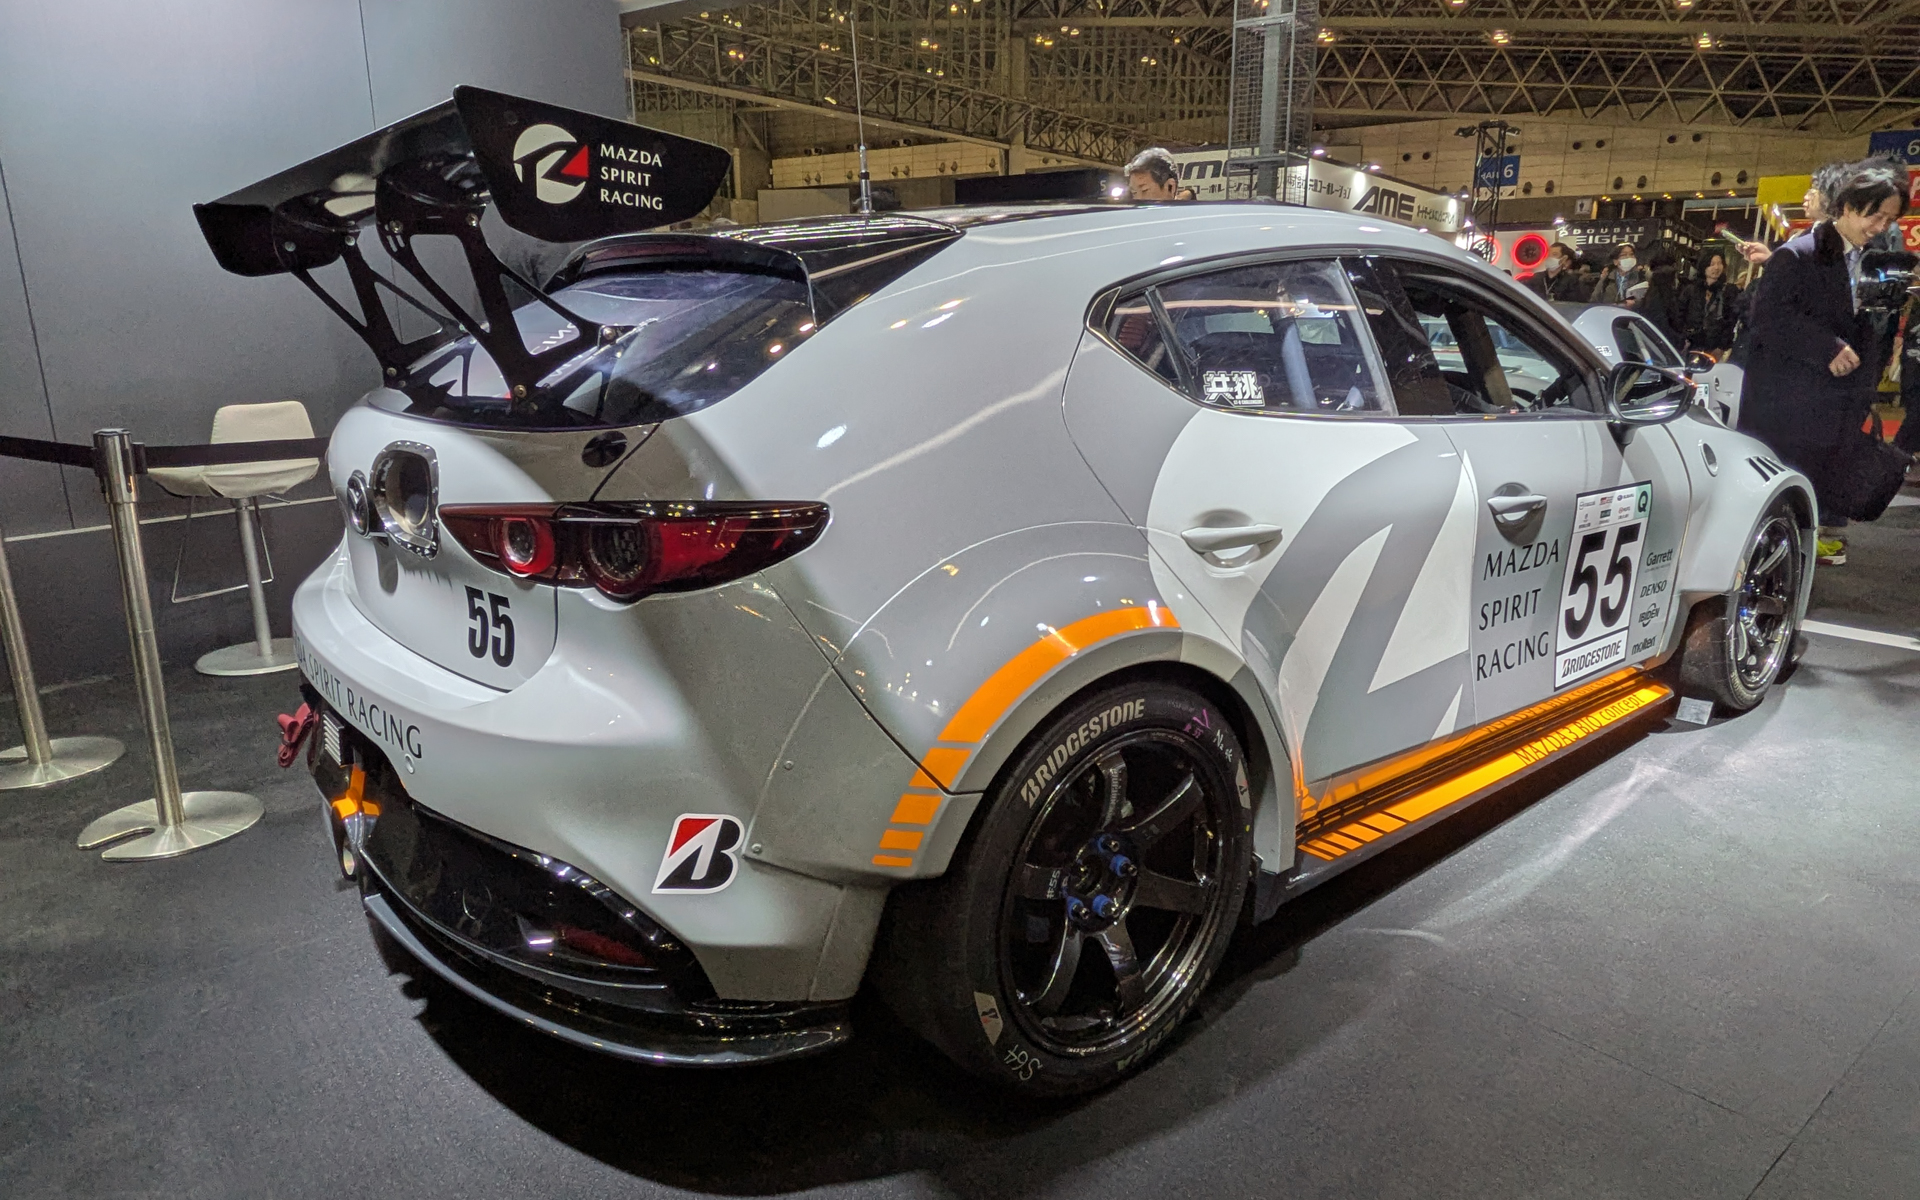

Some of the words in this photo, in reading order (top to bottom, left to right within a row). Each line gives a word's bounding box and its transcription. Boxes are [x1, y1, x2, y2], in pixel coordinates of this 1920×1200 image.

[601, 144, 663, 168] MAZDA
[1504, 164, 1514, 179] 6
[601, 167, 651, 187] SPIRIT
[601, 189, 663, 211] RACING
[1352, 185, 1416, 222] AME
[1573, 226, 1645, 235] DOUBLE
[1576, 233, 1644, 245] EIGHT
[1638, 490, 1649, 513] Q
[1483, 538, 1559, 581] MAZDA
[1646, 548, 1674, 567] Garrett
[1564, 522, 1641, 640] 55
[1640, 580, 1667, 598] DENSO
[464, 584, 515, 668] 55
[1478, 588, 1541, 631] SPIRIT
[1476, 631, 1549, 681] RACING
[1561, 639, 1622, 678] BRIDGESTONE
[308, 653, 342, 708] SPIRIT
[347, 686, 422, 759] RACING
[1576, 714, 1602, 737] BIO
[1599, 693, 1646, 726] concept
[1020, 698, 1145, 809] BRIDGESTONE
